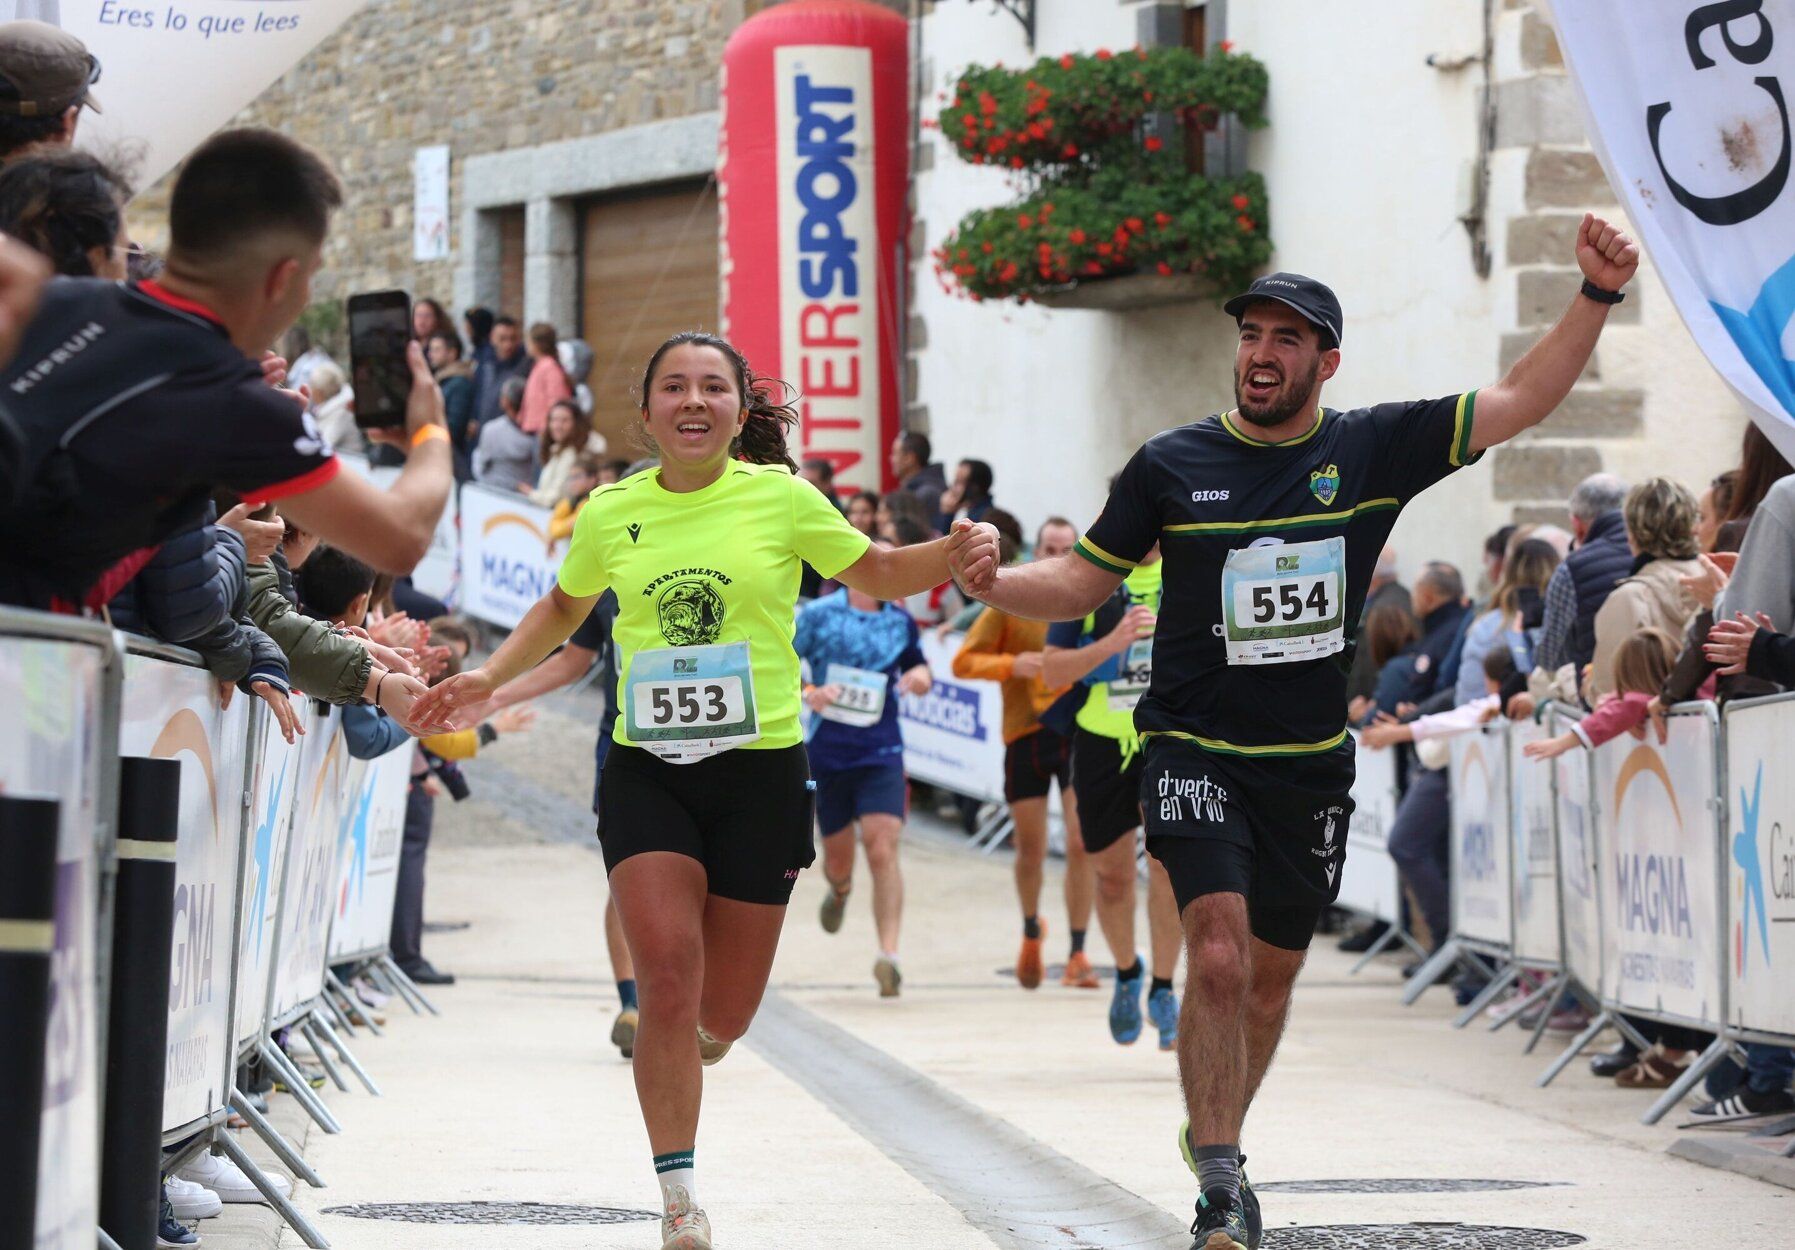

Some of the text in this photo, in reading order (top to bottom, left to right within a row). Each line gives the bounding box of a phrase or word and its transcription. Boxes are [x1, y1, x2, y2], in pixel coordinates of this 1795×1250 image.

[99, 1, 299, 39] Eres lo que lees
[795, 74, 862, 497] NTERSPORT
[1265, 280, 1298, 289] KIPRUN
[10, 321, 105, 394] KIPRUN
[1192, 490, 1230, 502] GIOS
[642, 568, 733, 597] APARTAMENTOS
[1252, 581, 1329, 623] 554
[652, 685, 728, 725] 553
[1160, 796, 1183, 821] en
[1615, 853, 1693, 939] MAGNA
